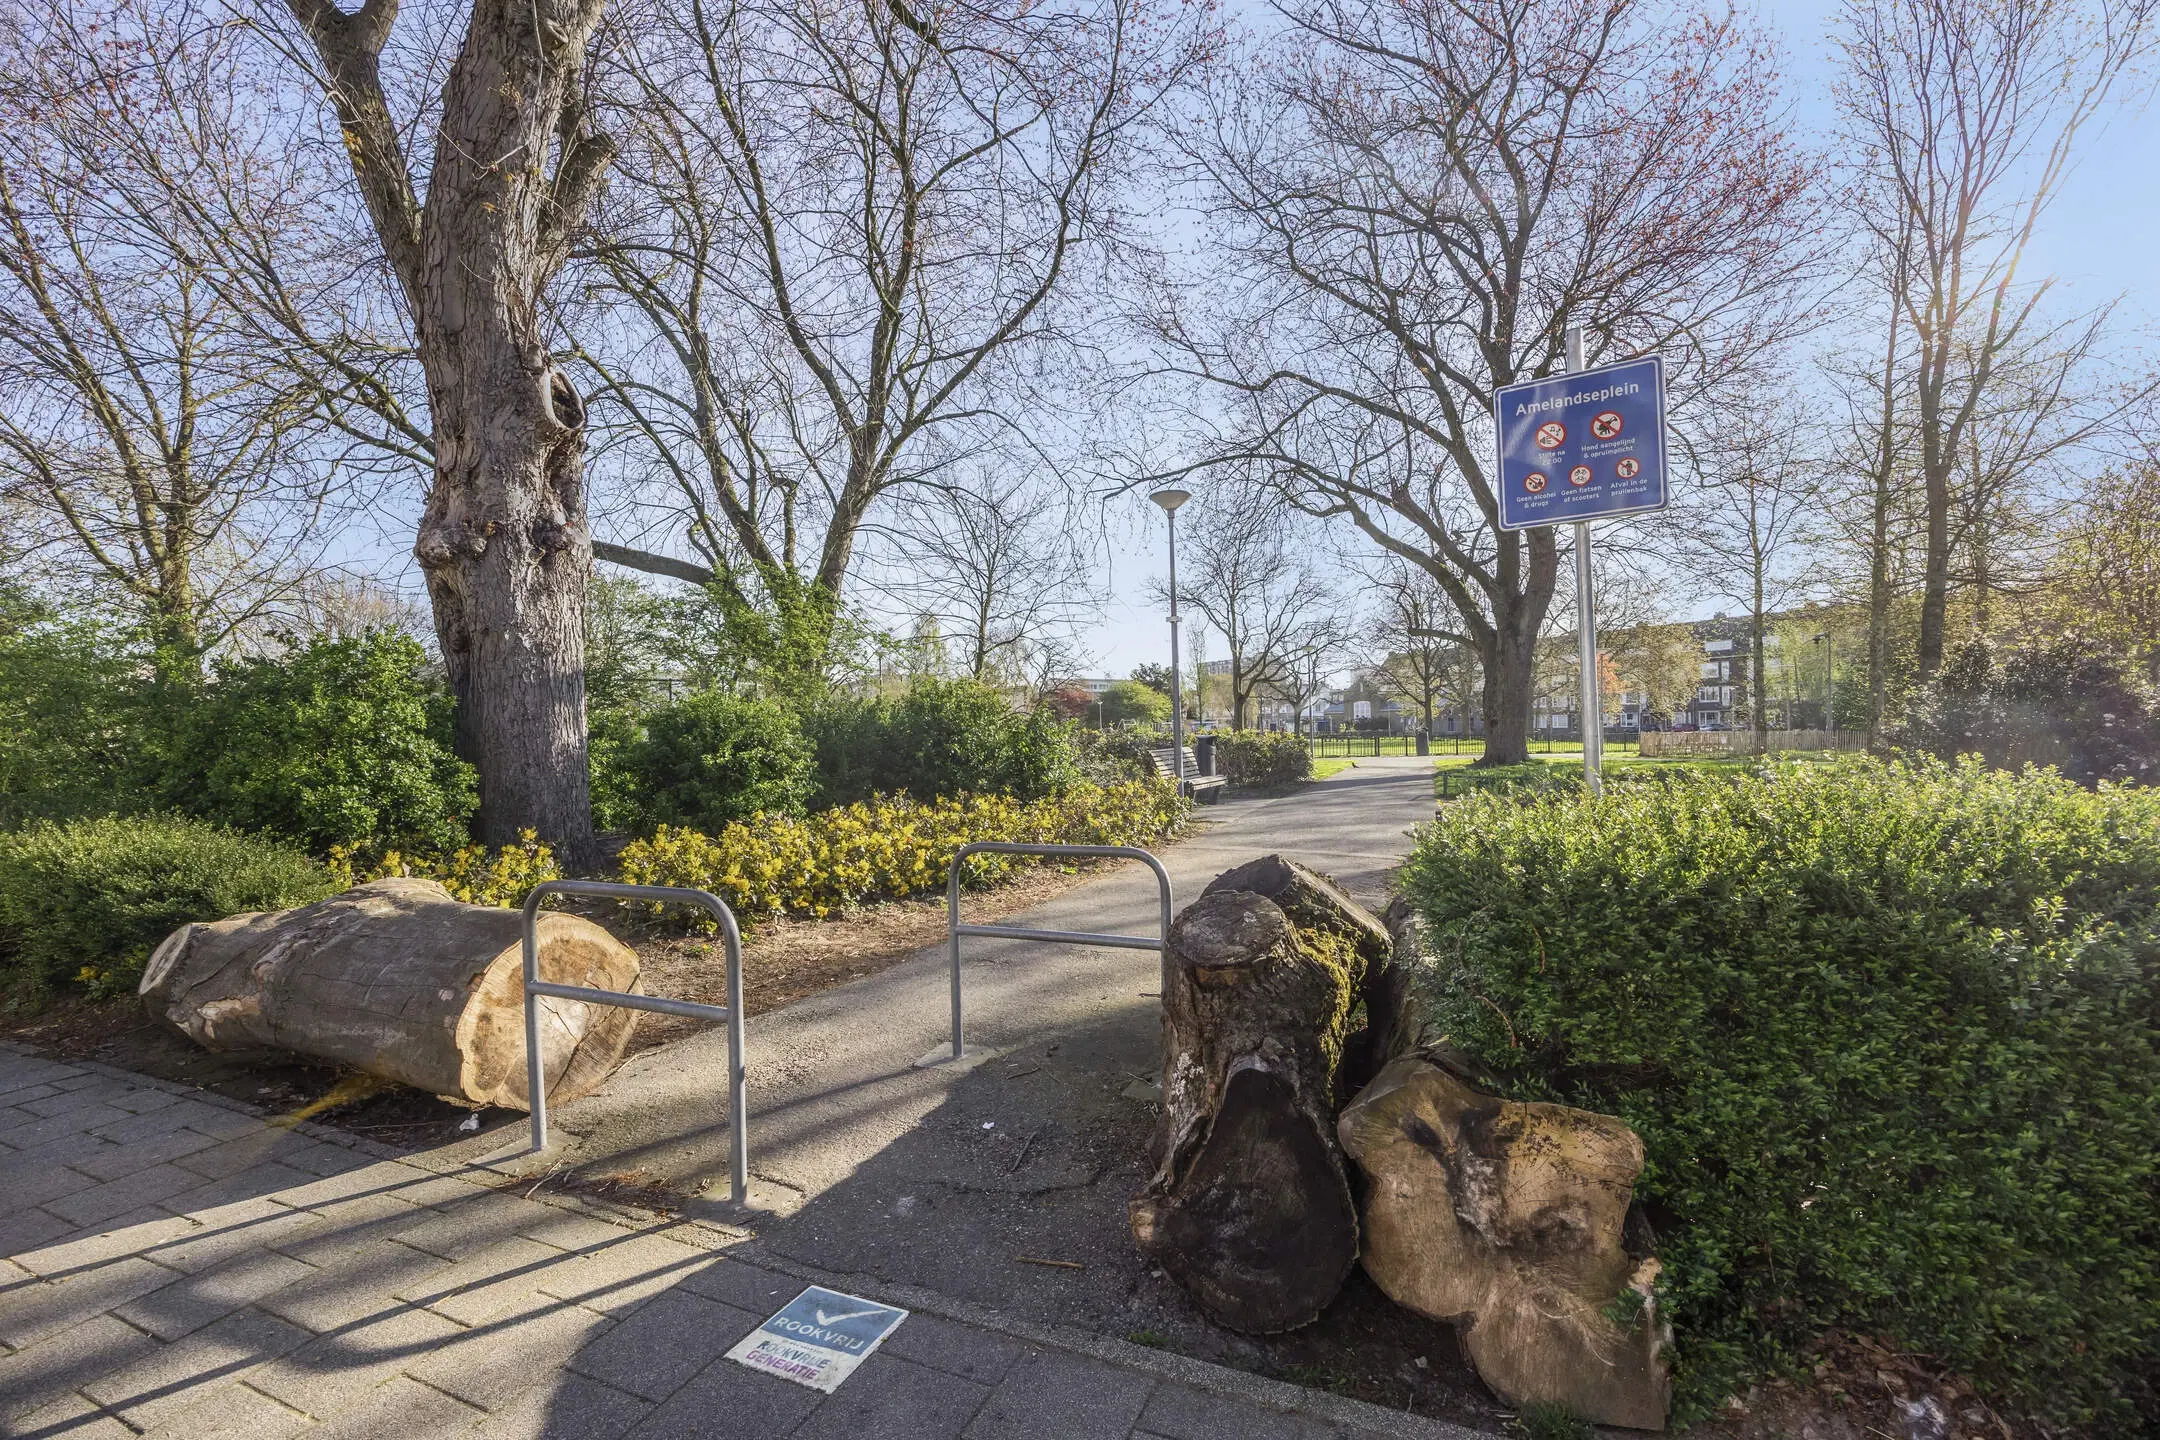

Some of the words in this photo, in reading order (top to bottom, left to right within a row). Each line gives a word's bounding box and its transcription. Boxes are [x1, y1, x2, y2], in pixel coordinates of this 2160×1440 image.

[1516, 382, 1639, 416] Amelandseplein
[1581, 444, 1599, 452] Hond
[1560, 488, 1578, 496] Geen
[1579, 485, 1602, 494] fietsen
[1516, 494, 1533, 502] Geen
[1530, 500, 1549, 508] drugs
[774, 1316, 865, 1350] ROOKVRIJ
[746, 1350, 820, 1380] GENERATIE
